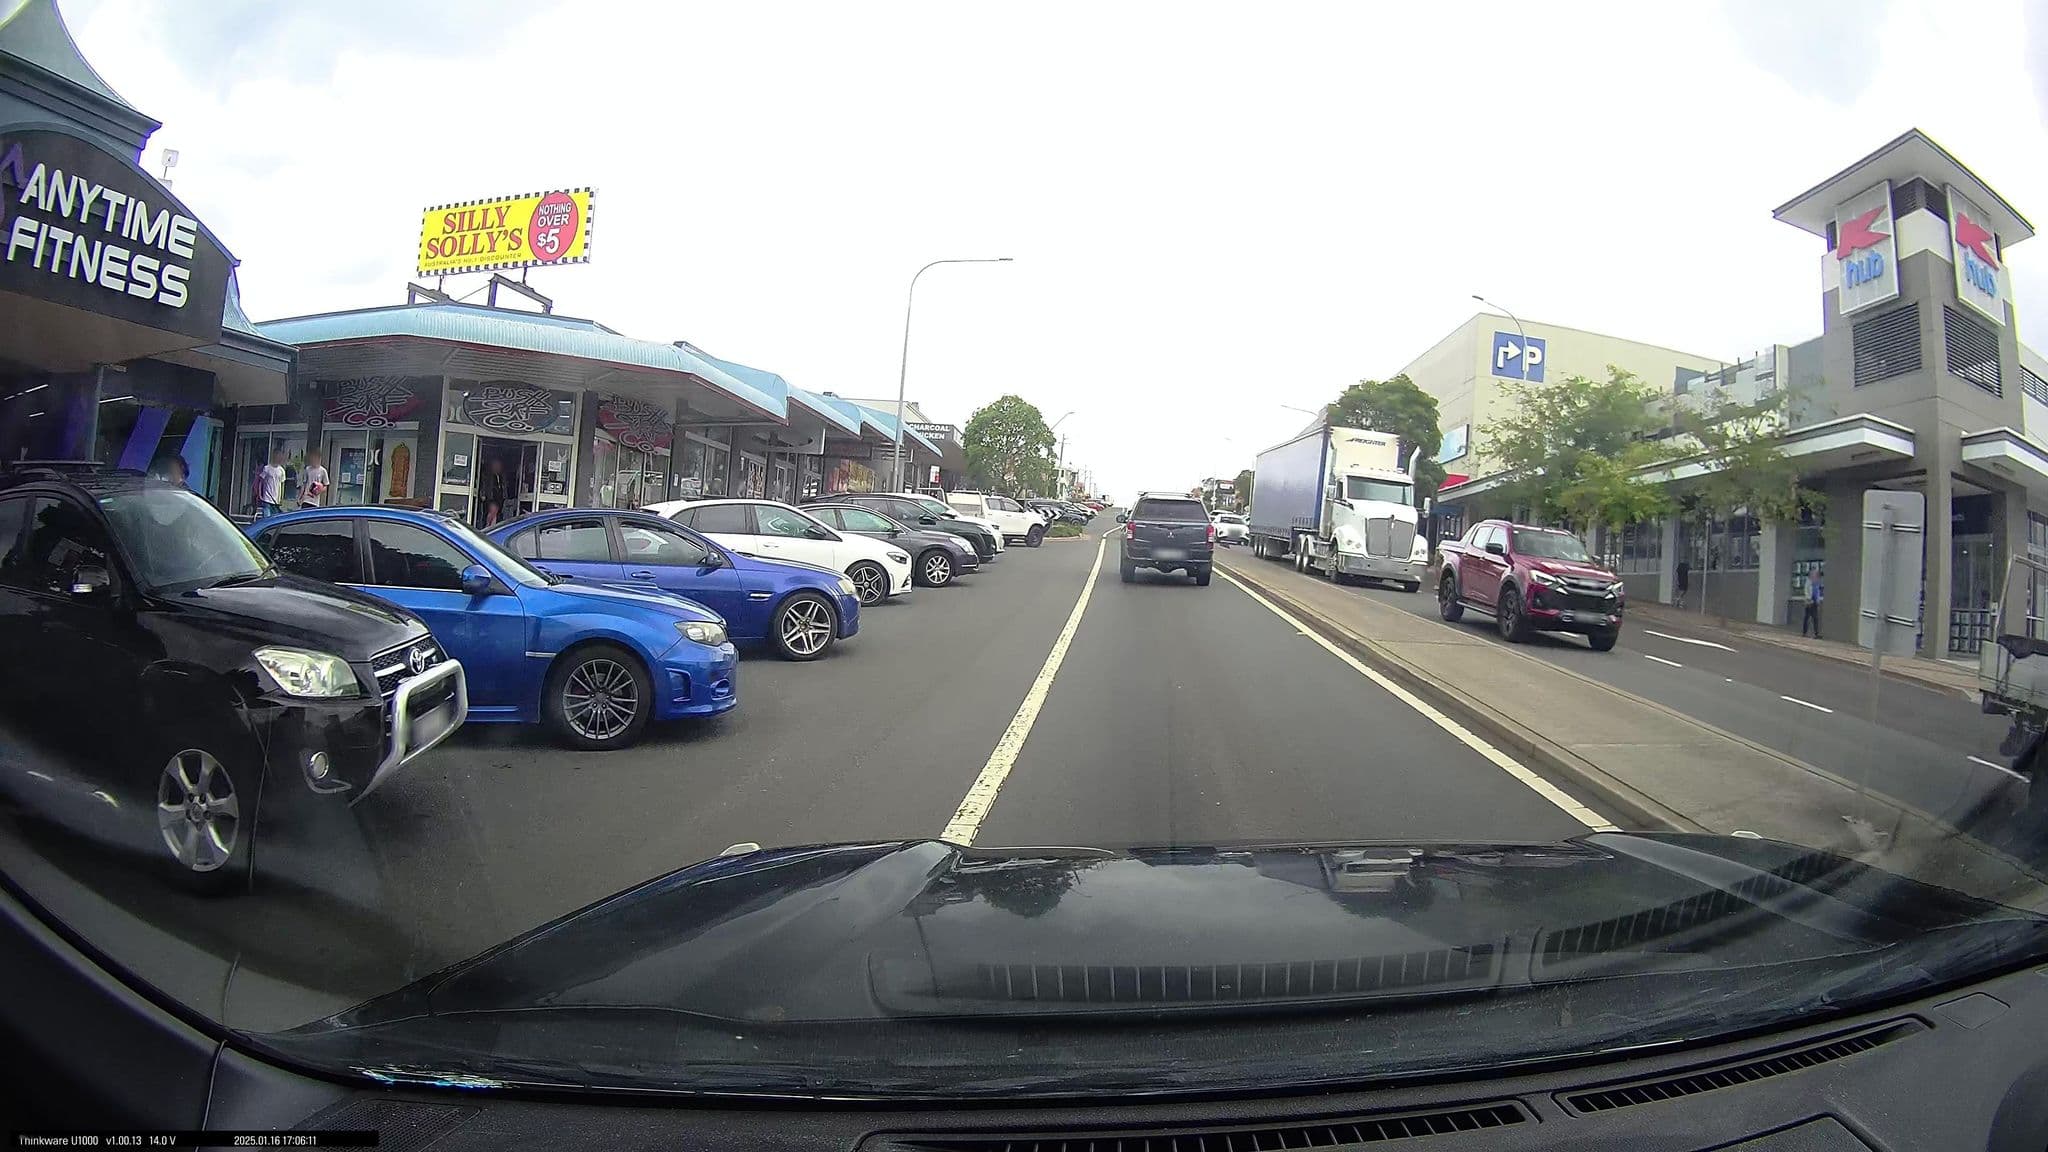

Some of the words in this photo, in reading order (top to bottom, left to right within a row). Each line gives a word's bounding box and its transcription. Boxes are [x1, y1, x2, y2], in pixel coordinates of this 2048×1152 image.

[20, 163, 198, 260] ANYTIME
[442, 205, 511, 235] SILLY
[537, 214, 570, 228] OVER
[538, 202, 572, 216] NOTHING
[425, 228, 523, 260] SOLLY'S
[536, 228, 561, 254] $5
[7, 216, 190, 308] FITNESS
[1844, 250, 1885, 289] hub
[1964, 252, 1997, 298] hub
[1522, 345, 1543, 372] P
[909, 424, 951, 432] CHARCOAL
